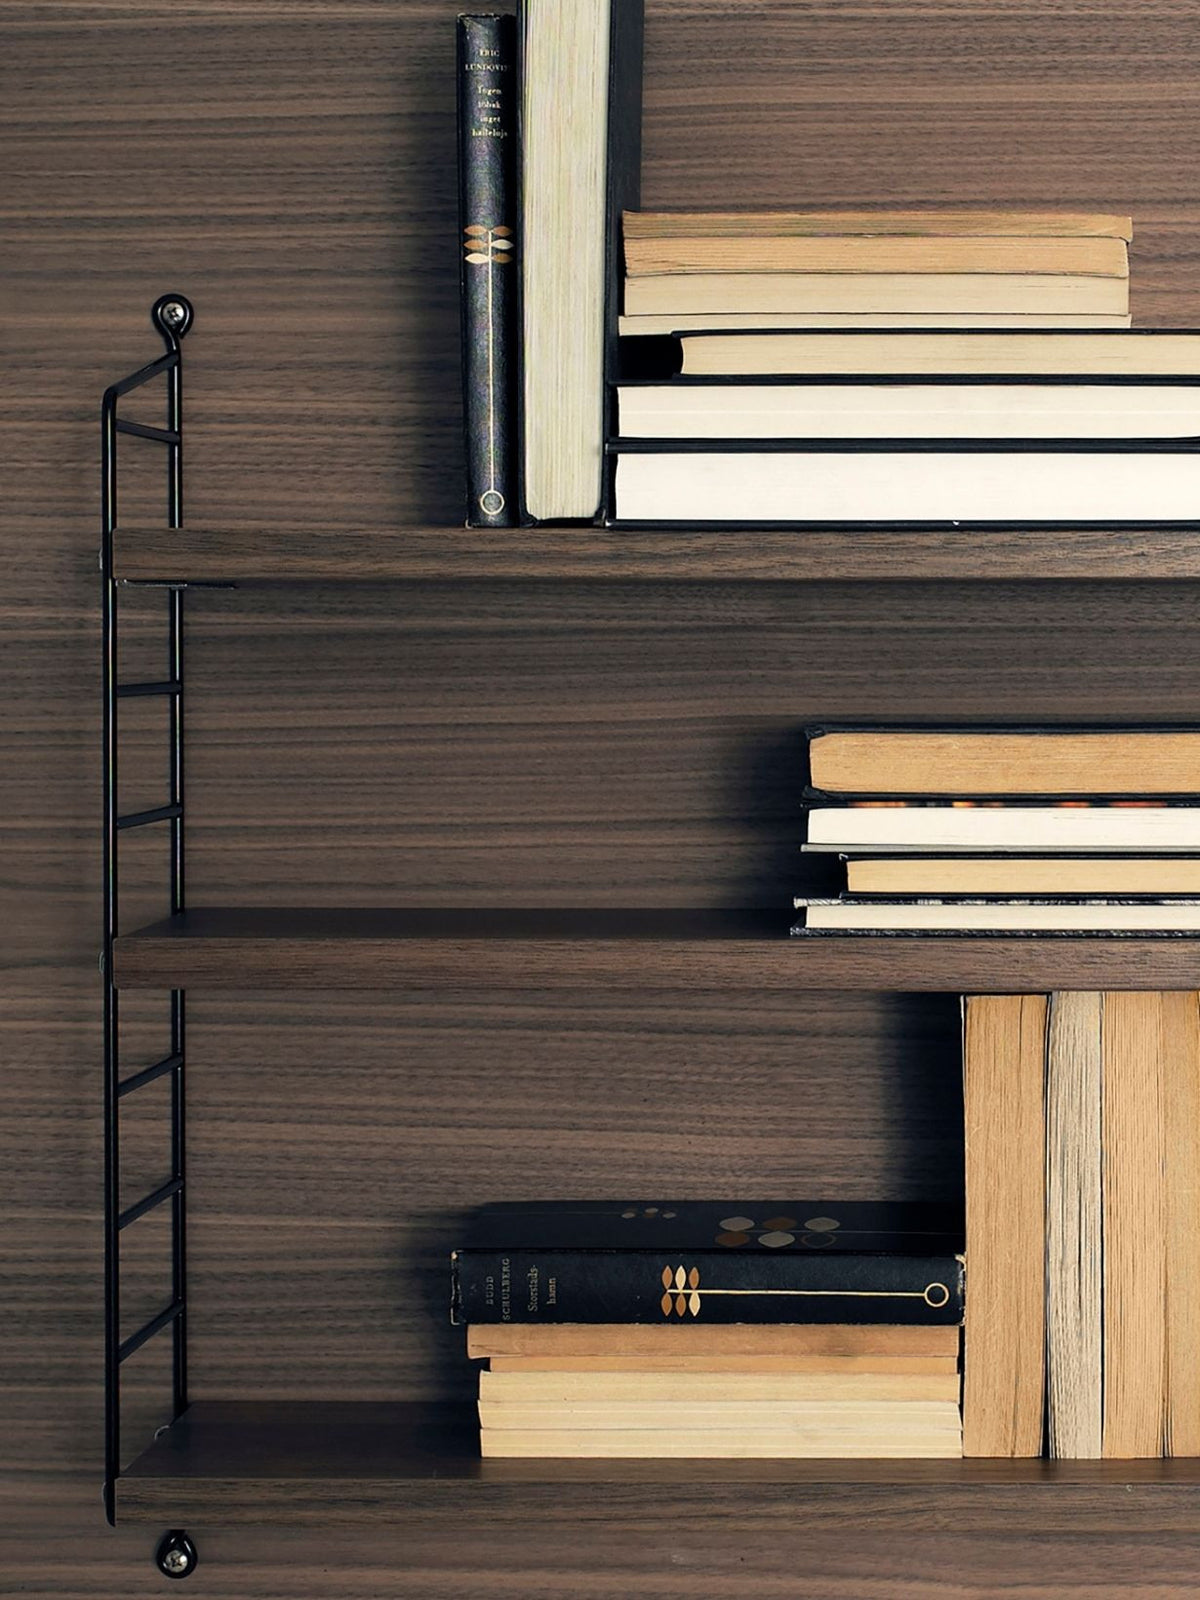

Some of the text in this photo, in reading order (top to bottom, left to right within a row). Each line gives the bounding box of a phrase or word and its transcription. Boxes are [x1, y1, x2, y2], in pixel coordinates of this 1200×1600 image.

[486, 1276, 494, 1305] BUDD
[502, 1258, 510, 1321] SCHULBERG
[527, 1265, 538, 1312] Storstads-
[546, 1277, 556, 1305] hamn
